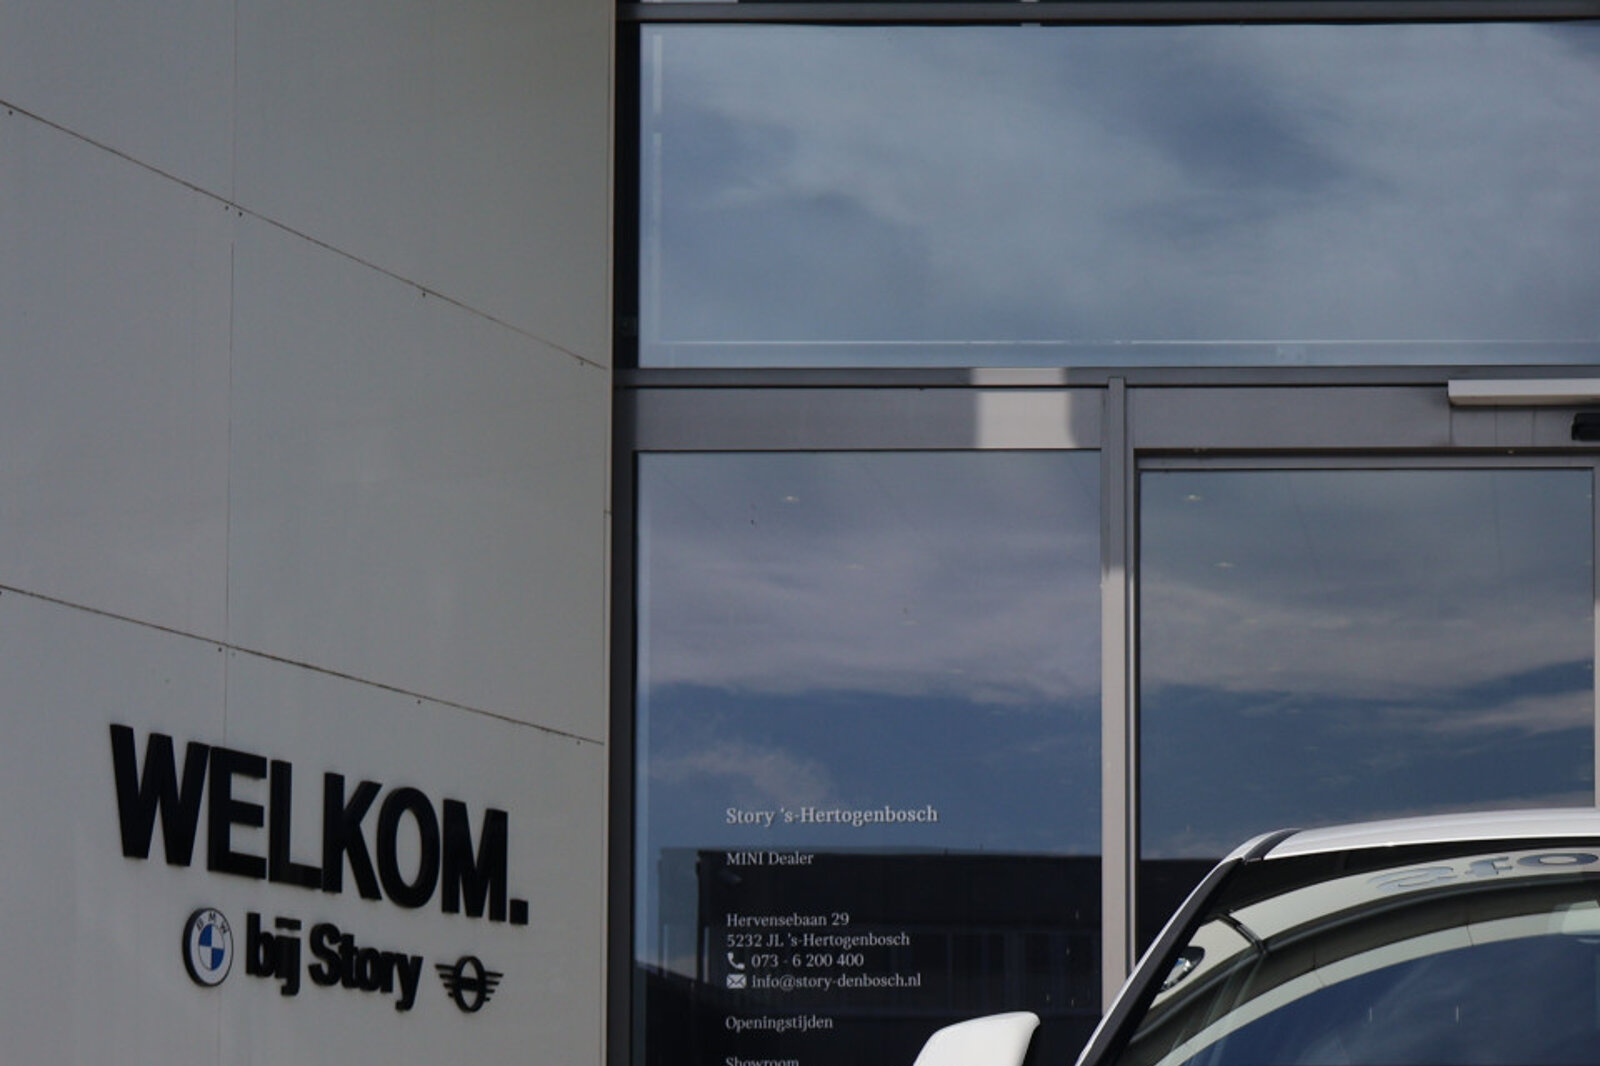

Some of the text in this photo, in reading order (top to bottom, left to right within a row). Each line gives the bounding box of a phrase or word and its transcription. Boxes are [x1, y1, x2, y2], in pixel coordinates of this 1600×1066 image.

[110, 724, 528, 925] WELKOM.
[726, 806, 939, 827] Story 's-Hertogenbosch
[727, 852, 814, 865] MINI Dealer
[727, 913, 850, 927] Hervensebaan 29
[727, 932, 910, 950] 5232 JL 's-Hertogenbosch
[246, 912, 423, 1012] bij Story
[751, 954, 779, 968] 073
[792, 954, 801, 967] 6
[806, 954, 833, 967] 200
[836, 954, 864, 967] 400
[751, 973, 921, 990] info@story-denbosch.nl
[726, 1016, 833, 1032] Openingstijden
